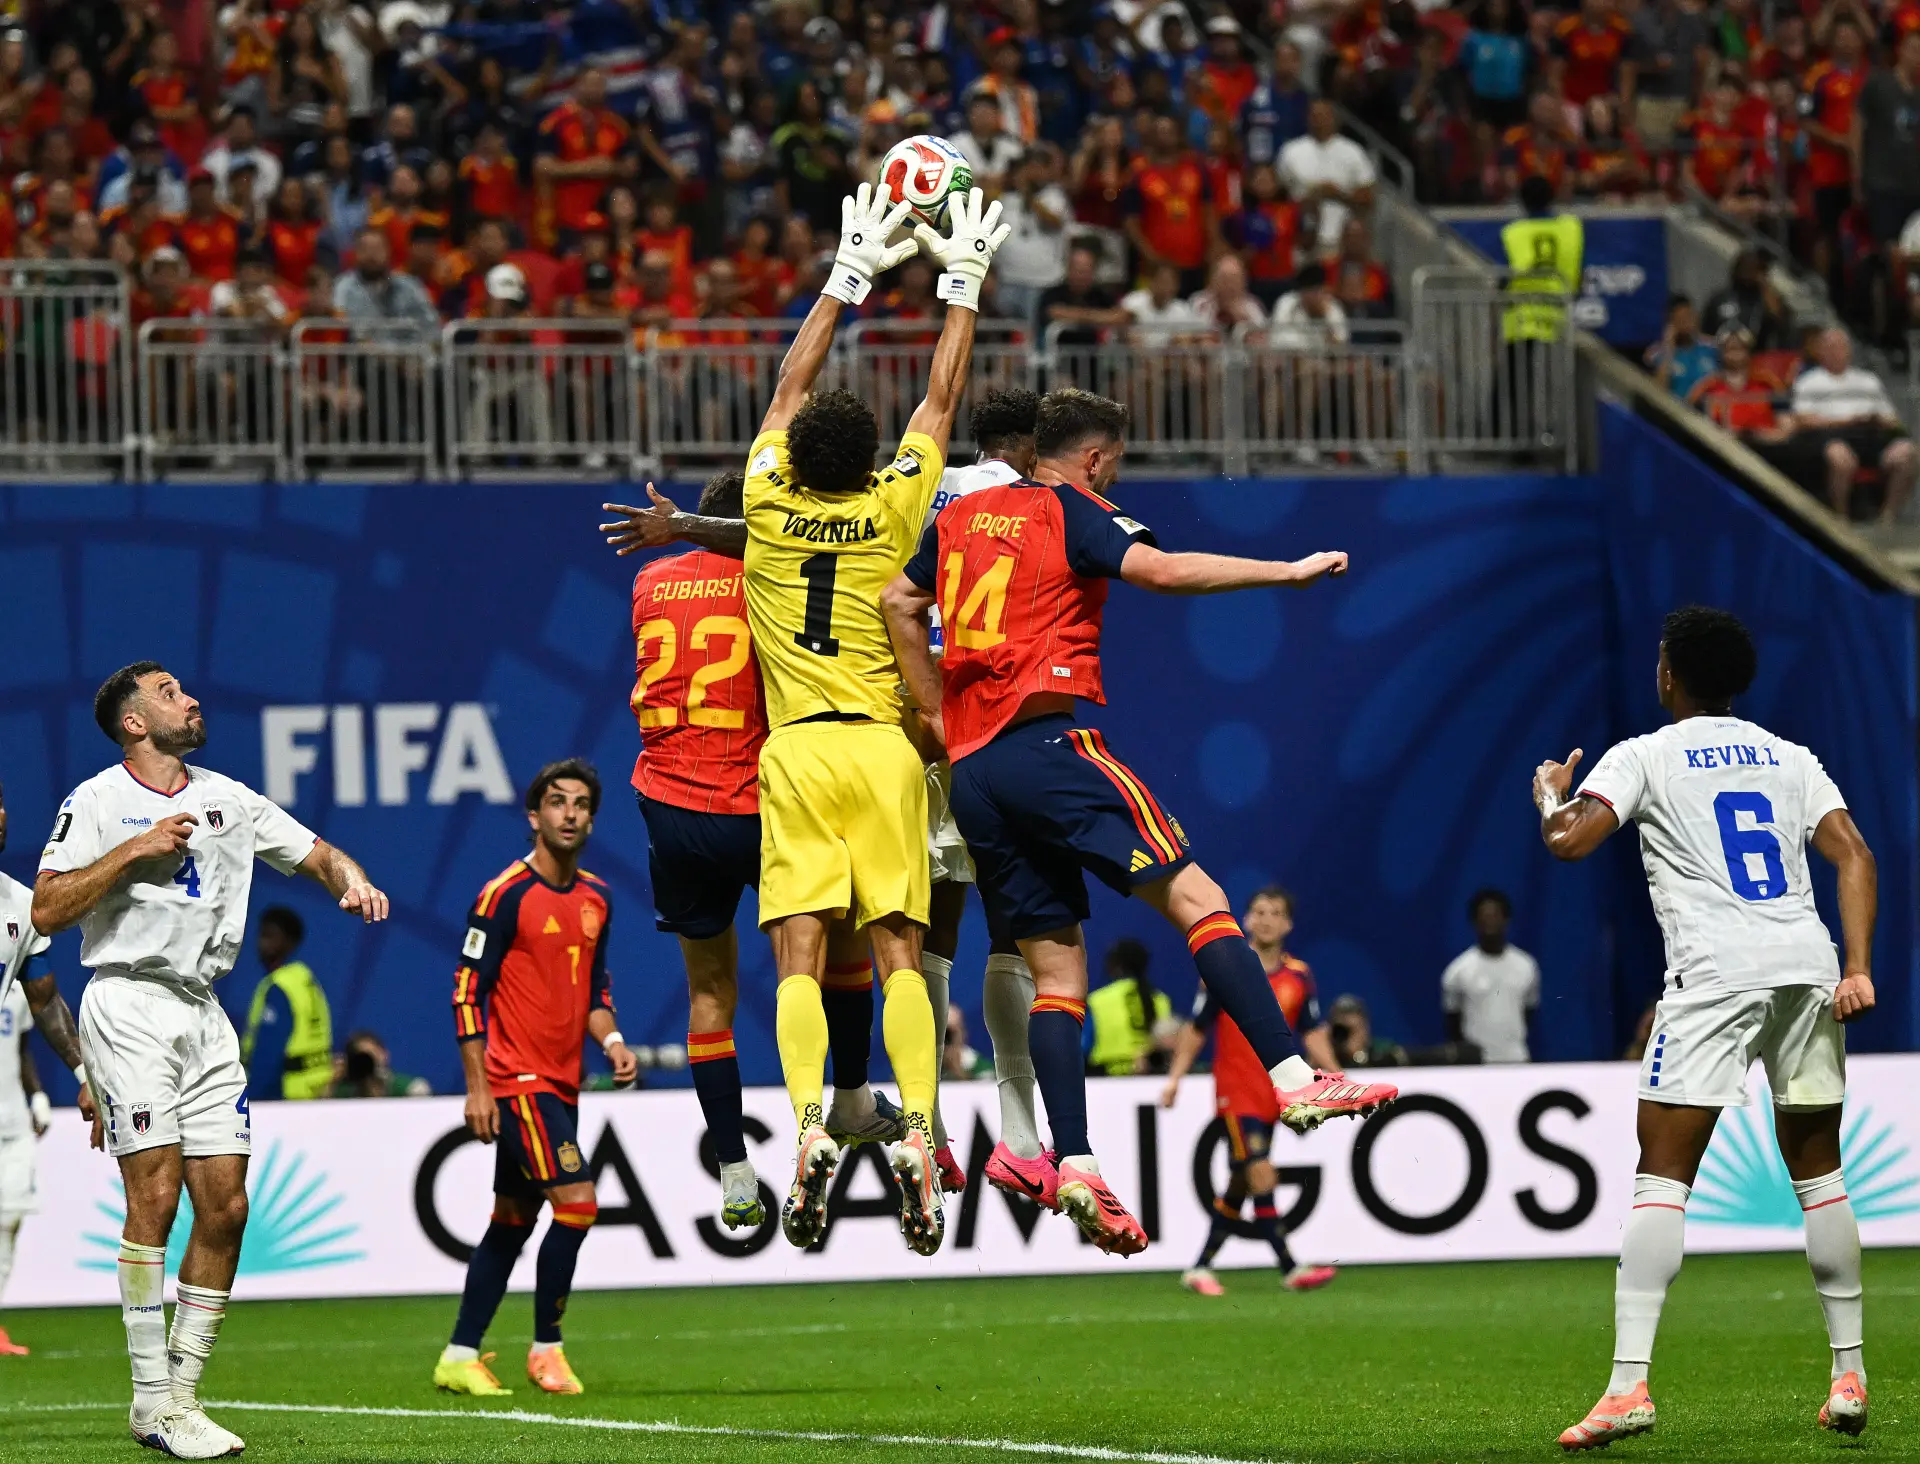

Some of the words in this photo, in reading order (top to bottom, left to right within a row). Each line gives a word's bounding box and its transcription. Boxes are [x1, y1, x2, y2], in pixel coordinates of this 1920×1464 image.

[782, 512, 878, 543] VOZINHA
[653, 573, 743, 602] CUBARSÍ
[794, 552, 839, 657] 1
[943, 551, 1015, 658] 14
[633, 615, 751, 729] 22
[260, 702, 517, 808] FIFA
[121, 816, 152, 826] capelli
[1713, 791, 1788, 900] 6
[173, 856, 201, 898] 4
[566, 945, 581, 986] 7
[131, 1103, 150, 1111] FCF
[234, 1084, 251, 1129] 4
[235, 1132, 251, 1142] cap
[413, 1088, 1599, 1264] CASAMIGOS
